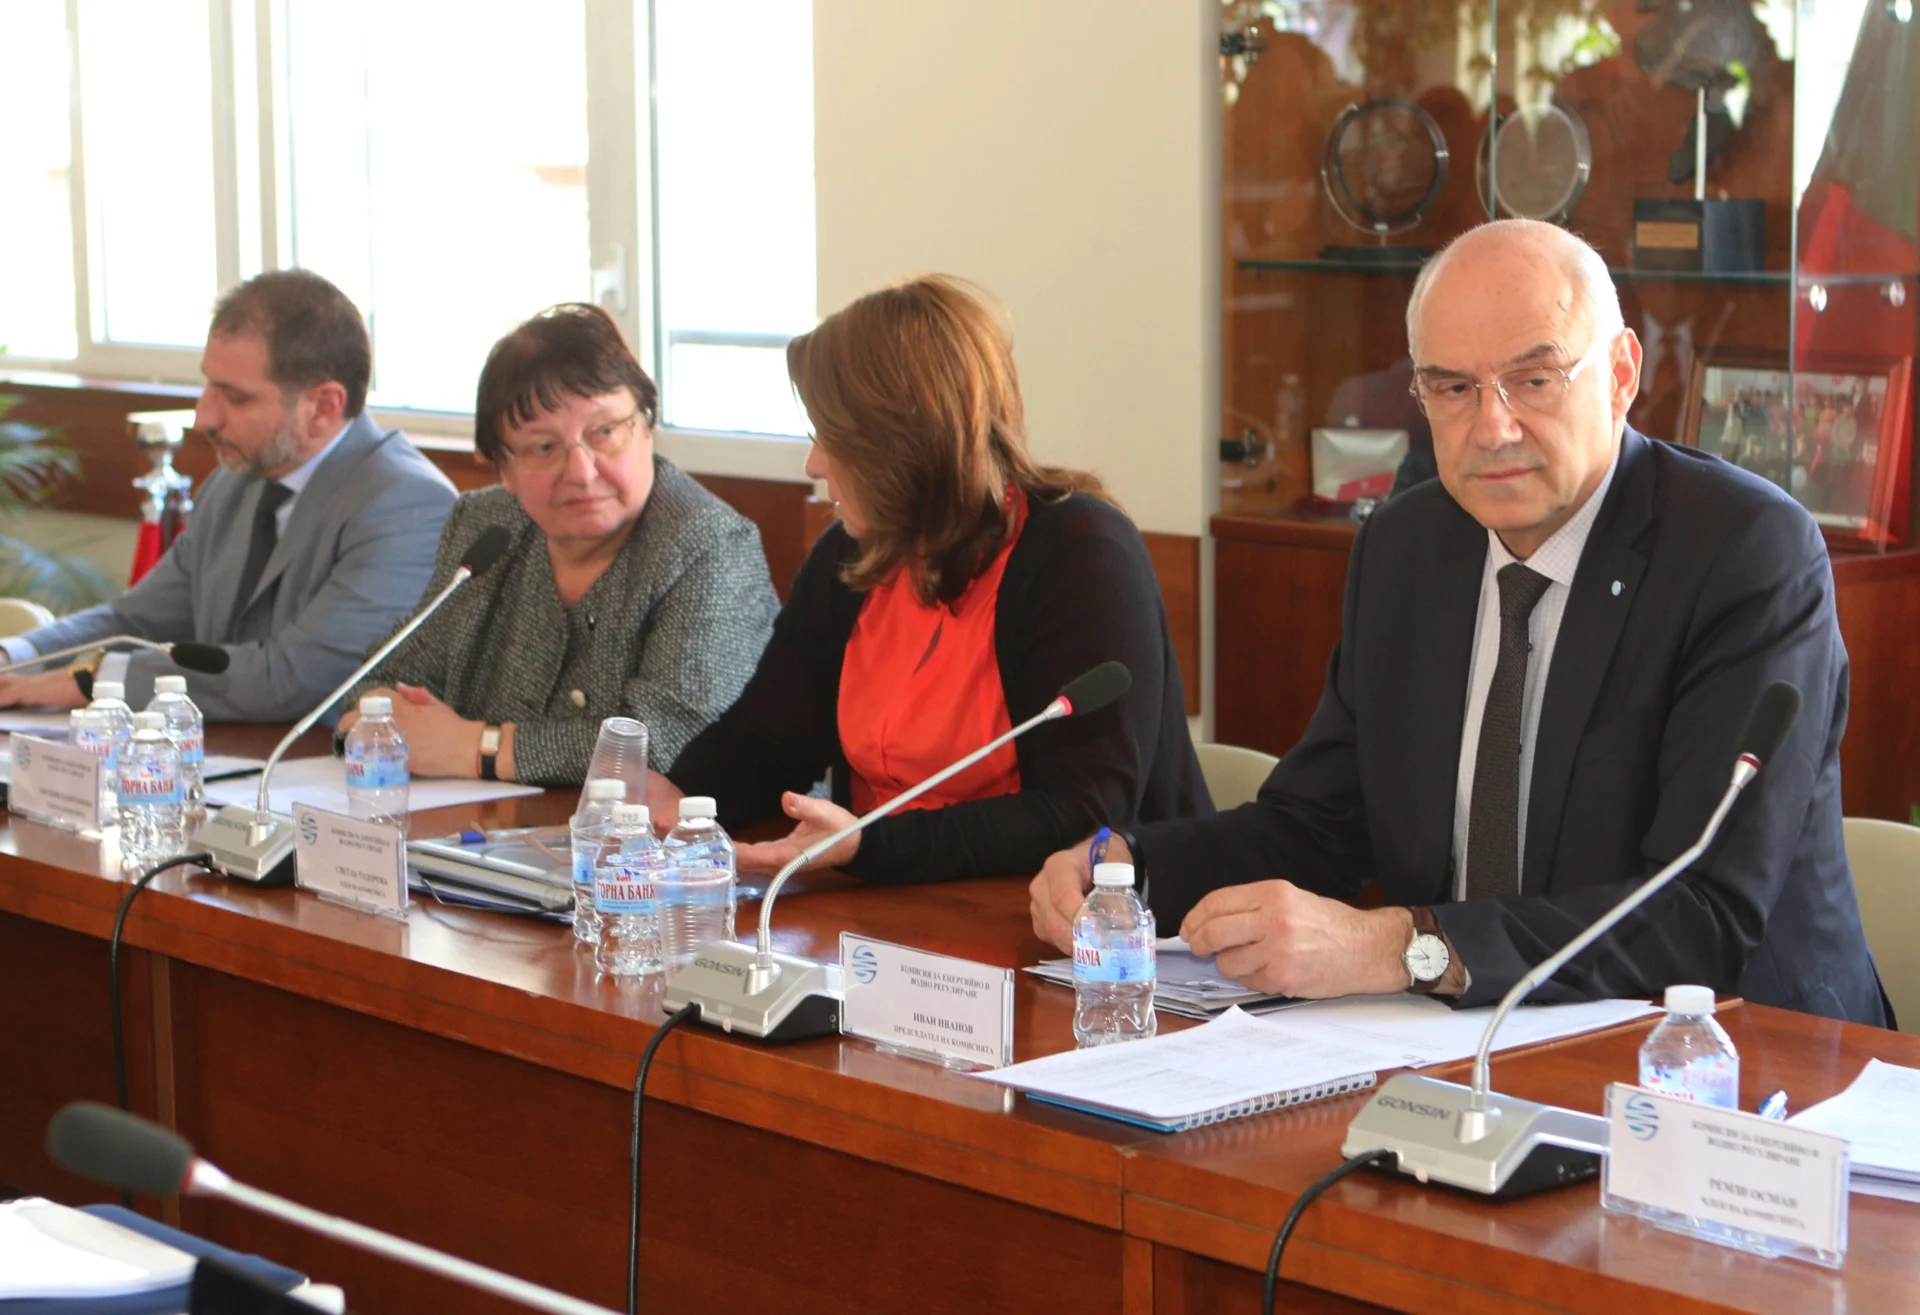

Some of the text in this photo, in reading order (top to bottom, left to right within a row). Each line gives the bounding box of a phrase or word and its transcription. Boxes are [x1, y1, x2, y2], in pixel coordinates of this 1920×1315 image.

[597, 882, 625, 900] ГОРНА
[900, 964, 932, 978] КОМИСИЯ
[933, 972, 941, 981] ЗА
[942, 973, 984, 989] ЕНЕРГИЙНО
[910, 977, 978, 998] ВОДНО РЕГУЛИРАНЕ
[913, 1012, 974, 1034] ИВАН ИВАНОВ
[893, 1024, 940, 1041] ПРЕДСЕДАТЕЛ
[951, 1038, 995, 1055] КОМИСИЯТА
[1377, 1095, 1452, 1119] GONSIN
